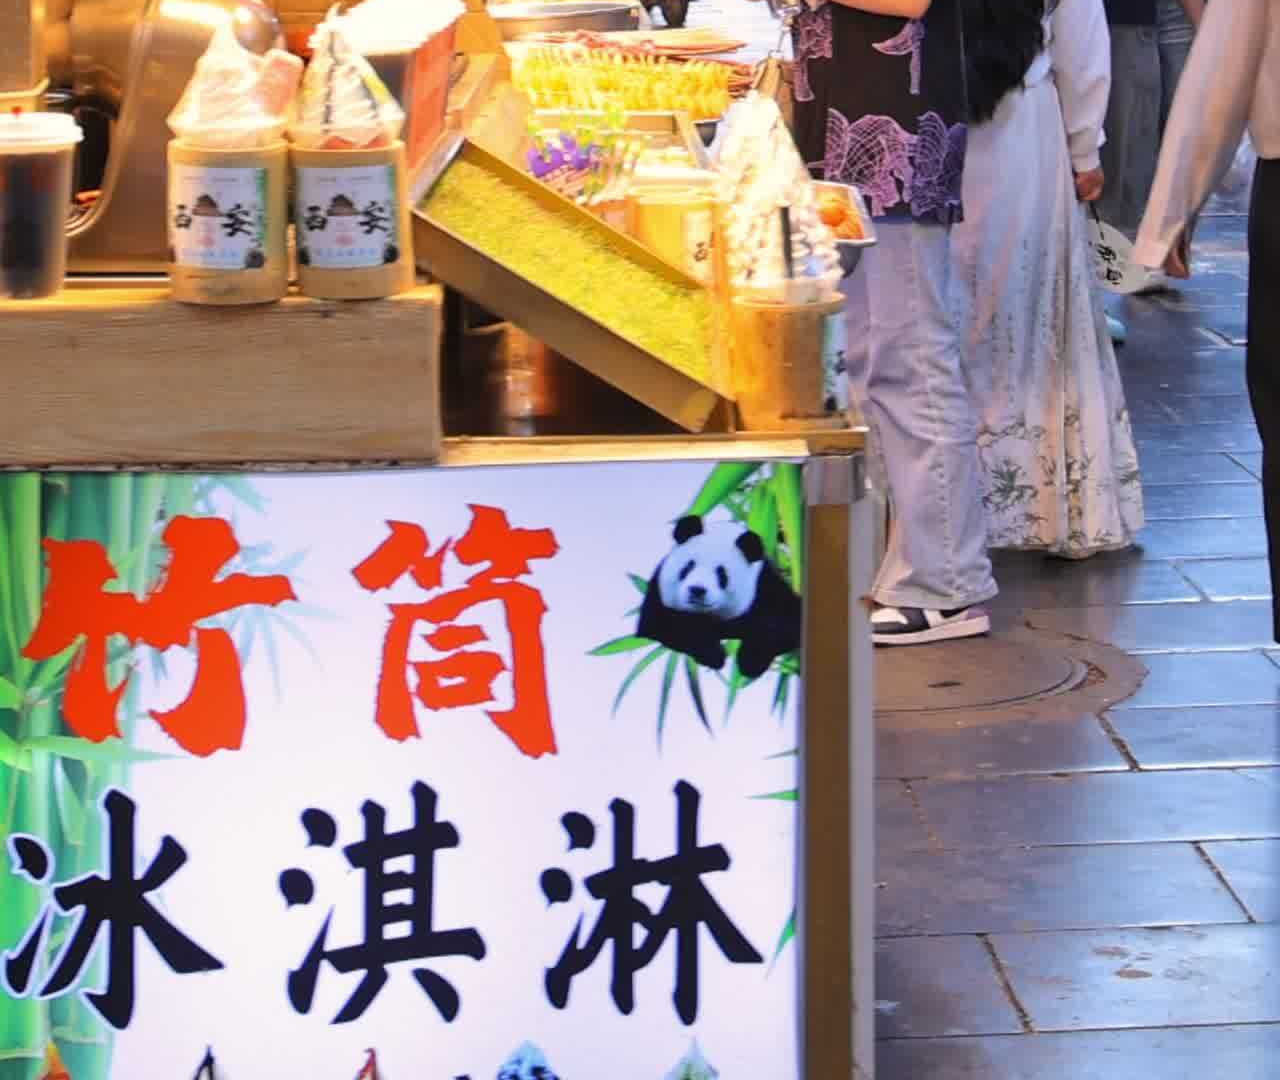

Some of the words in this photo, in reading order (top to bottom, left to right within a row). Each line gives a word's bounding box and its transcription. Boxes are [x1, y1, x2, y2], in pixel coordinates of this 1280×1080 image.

[21, 503, 560, 758] 竹筒
[7, 778, 763, 1030] 冰淇淋
